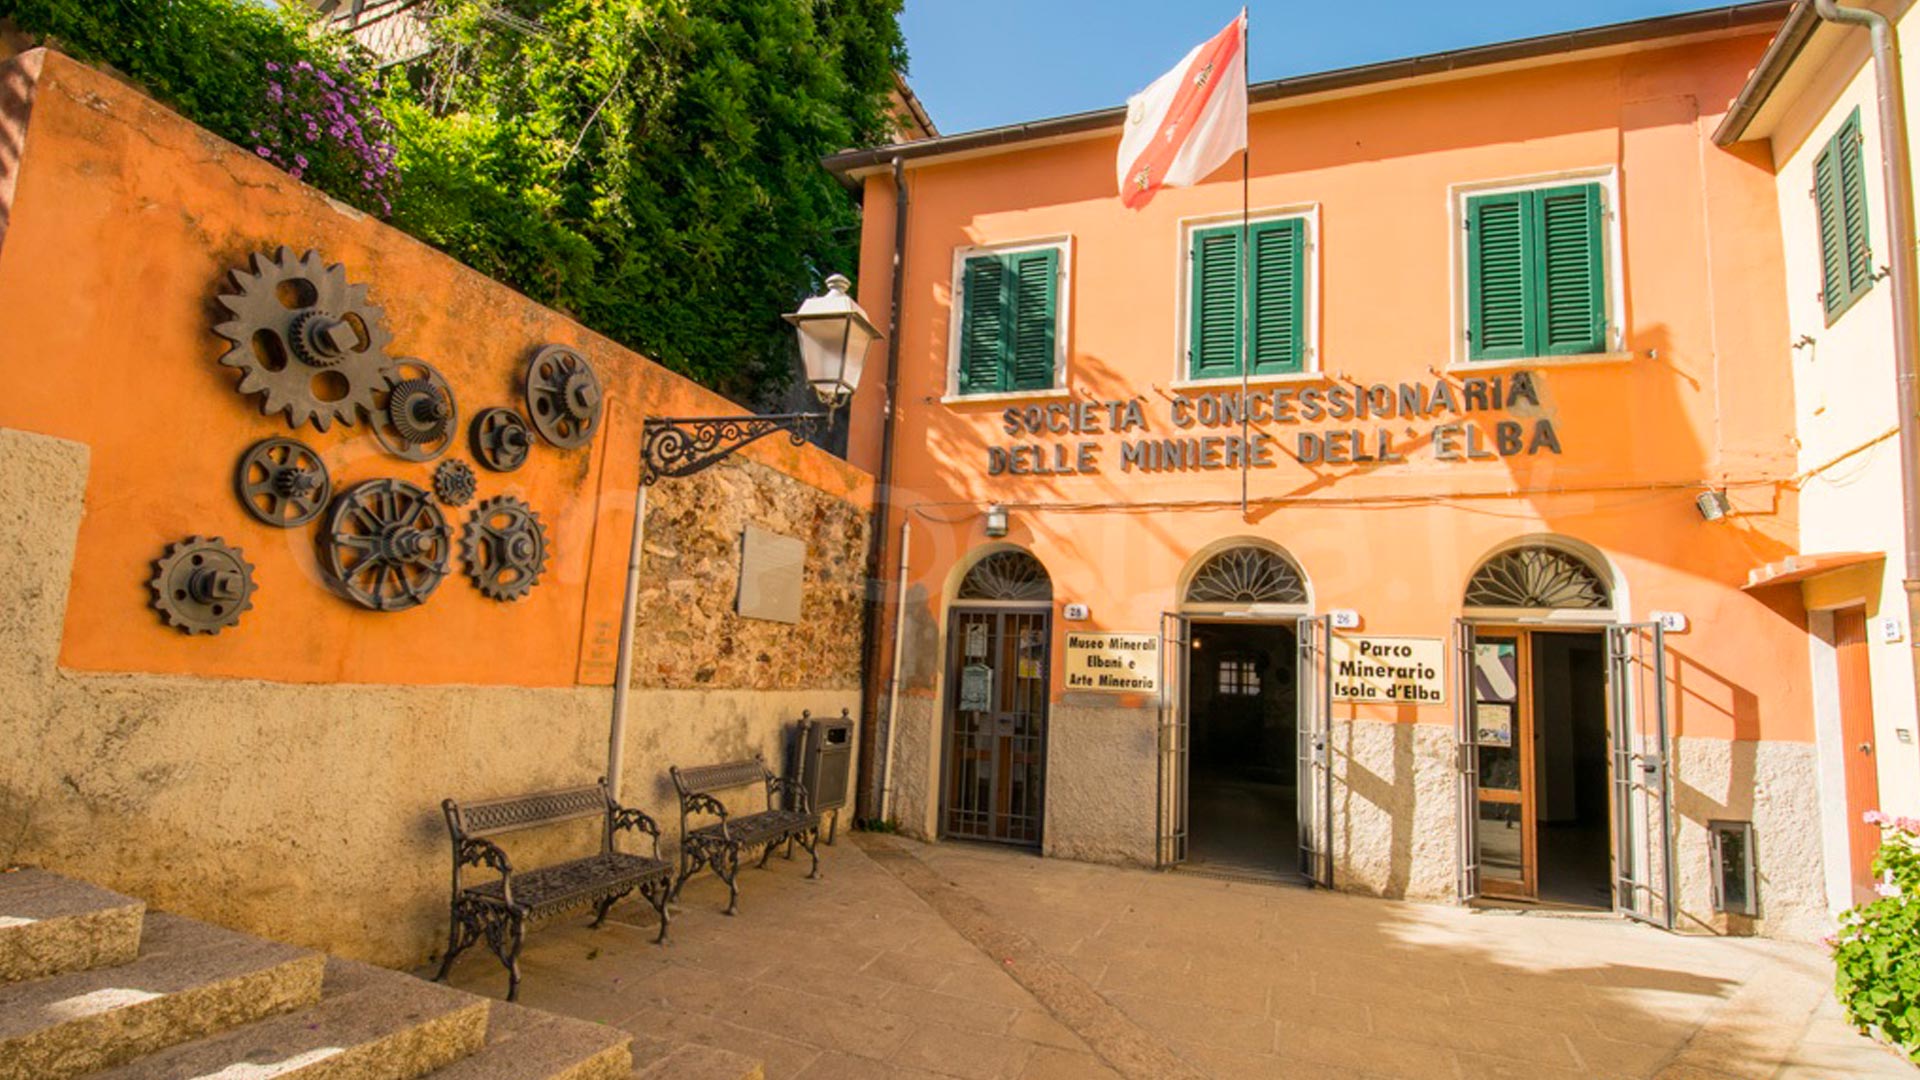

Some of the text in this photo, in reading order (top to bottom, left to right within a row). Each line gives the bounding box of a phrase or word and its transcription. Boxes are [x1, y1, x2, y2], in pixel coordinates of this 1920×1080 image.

[1170, 369, 1540, 429] CONCESSIONARIA
[988, 440, 1099, 478] DELLE
[1120, 434, 1275, 473] MINIERE
[1069, 636, 1156, 651] Museo Minerali
[1360, 640, 1412, 657] Parco
[1087, 654, 1136, 669] Elbani e
[1339, 660, 1436, 680] Minerario
[1069, 673, 1154, 689] Arte Mineraria
[1334, 681, 1441, 701] Isola d'Elba
